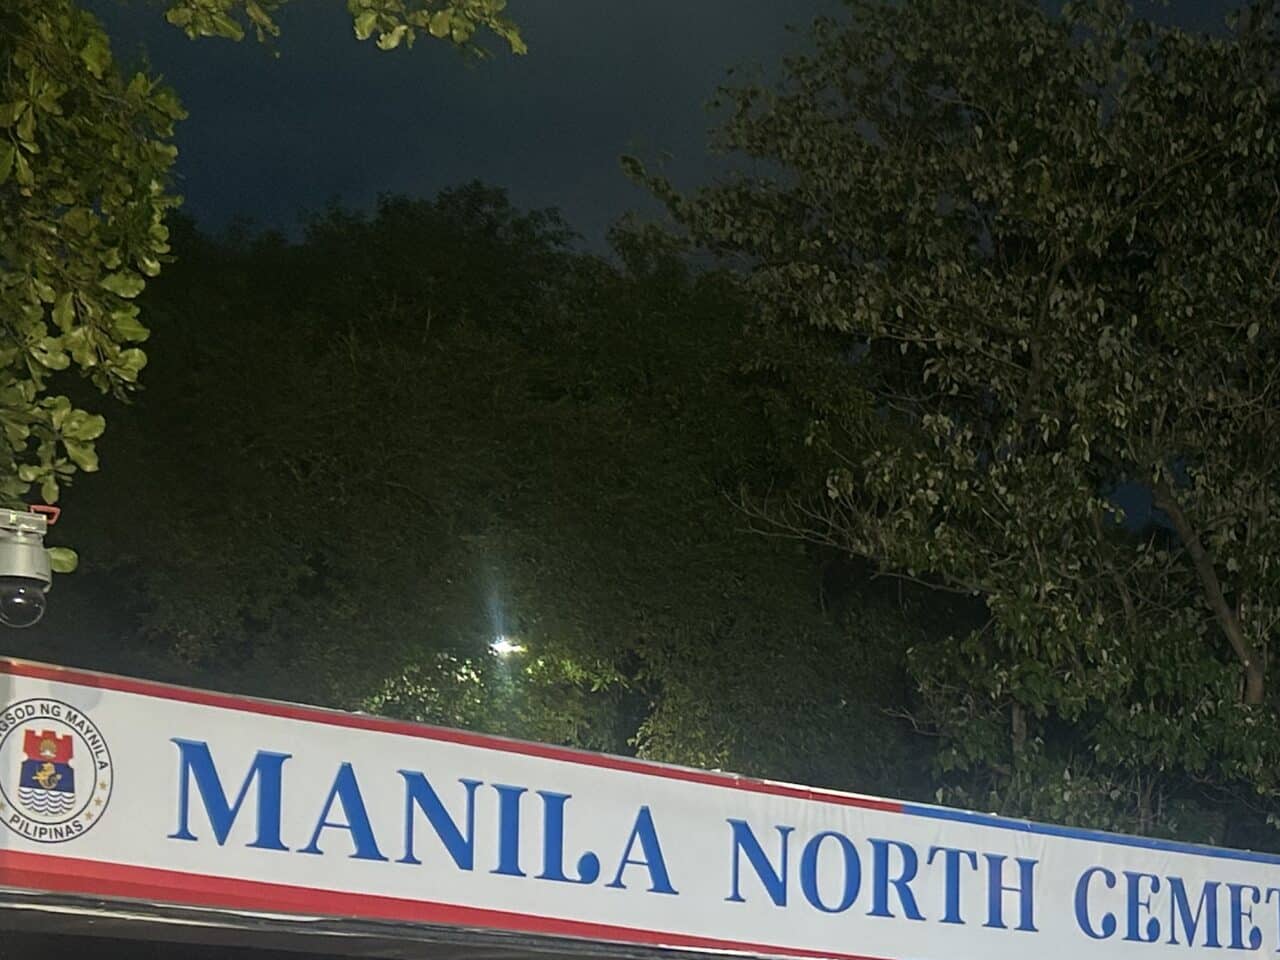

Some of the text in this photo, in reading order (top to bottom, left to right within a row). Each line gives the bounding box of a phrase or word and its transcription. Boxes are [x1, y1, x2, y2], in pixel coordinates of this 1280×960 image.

[0, 703, 109, 770] GSOD NG MAYNILA
[9, 814, 83, 840] PILIPINAS
[167, 736, 680, 895] MANILA
[724, 817, 1040, 932] NORTH
